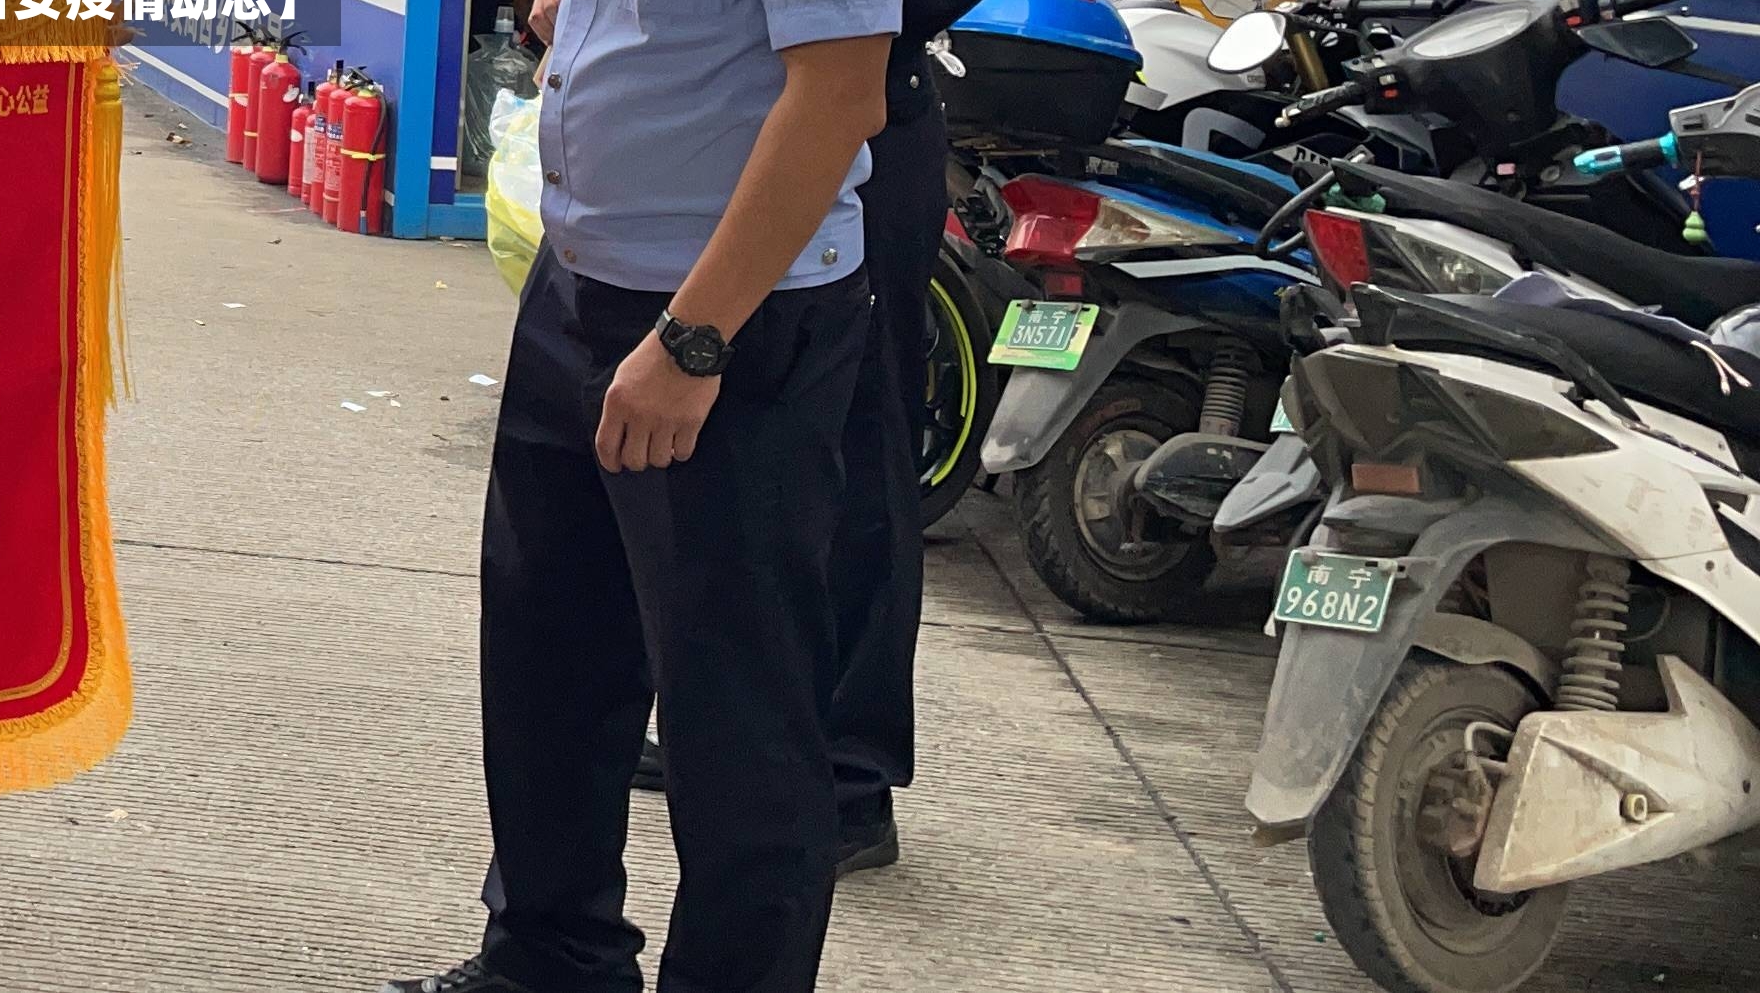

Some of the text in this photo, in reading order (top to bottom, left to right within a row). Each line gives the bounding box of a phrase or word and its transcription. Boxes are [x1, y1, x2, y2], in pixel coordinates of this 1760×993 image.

[1013, 325, 1066, 345] 3N571
[1307, 564, 1372, 589] 南宁
[1285, 587, 1378, 625] 968N2
